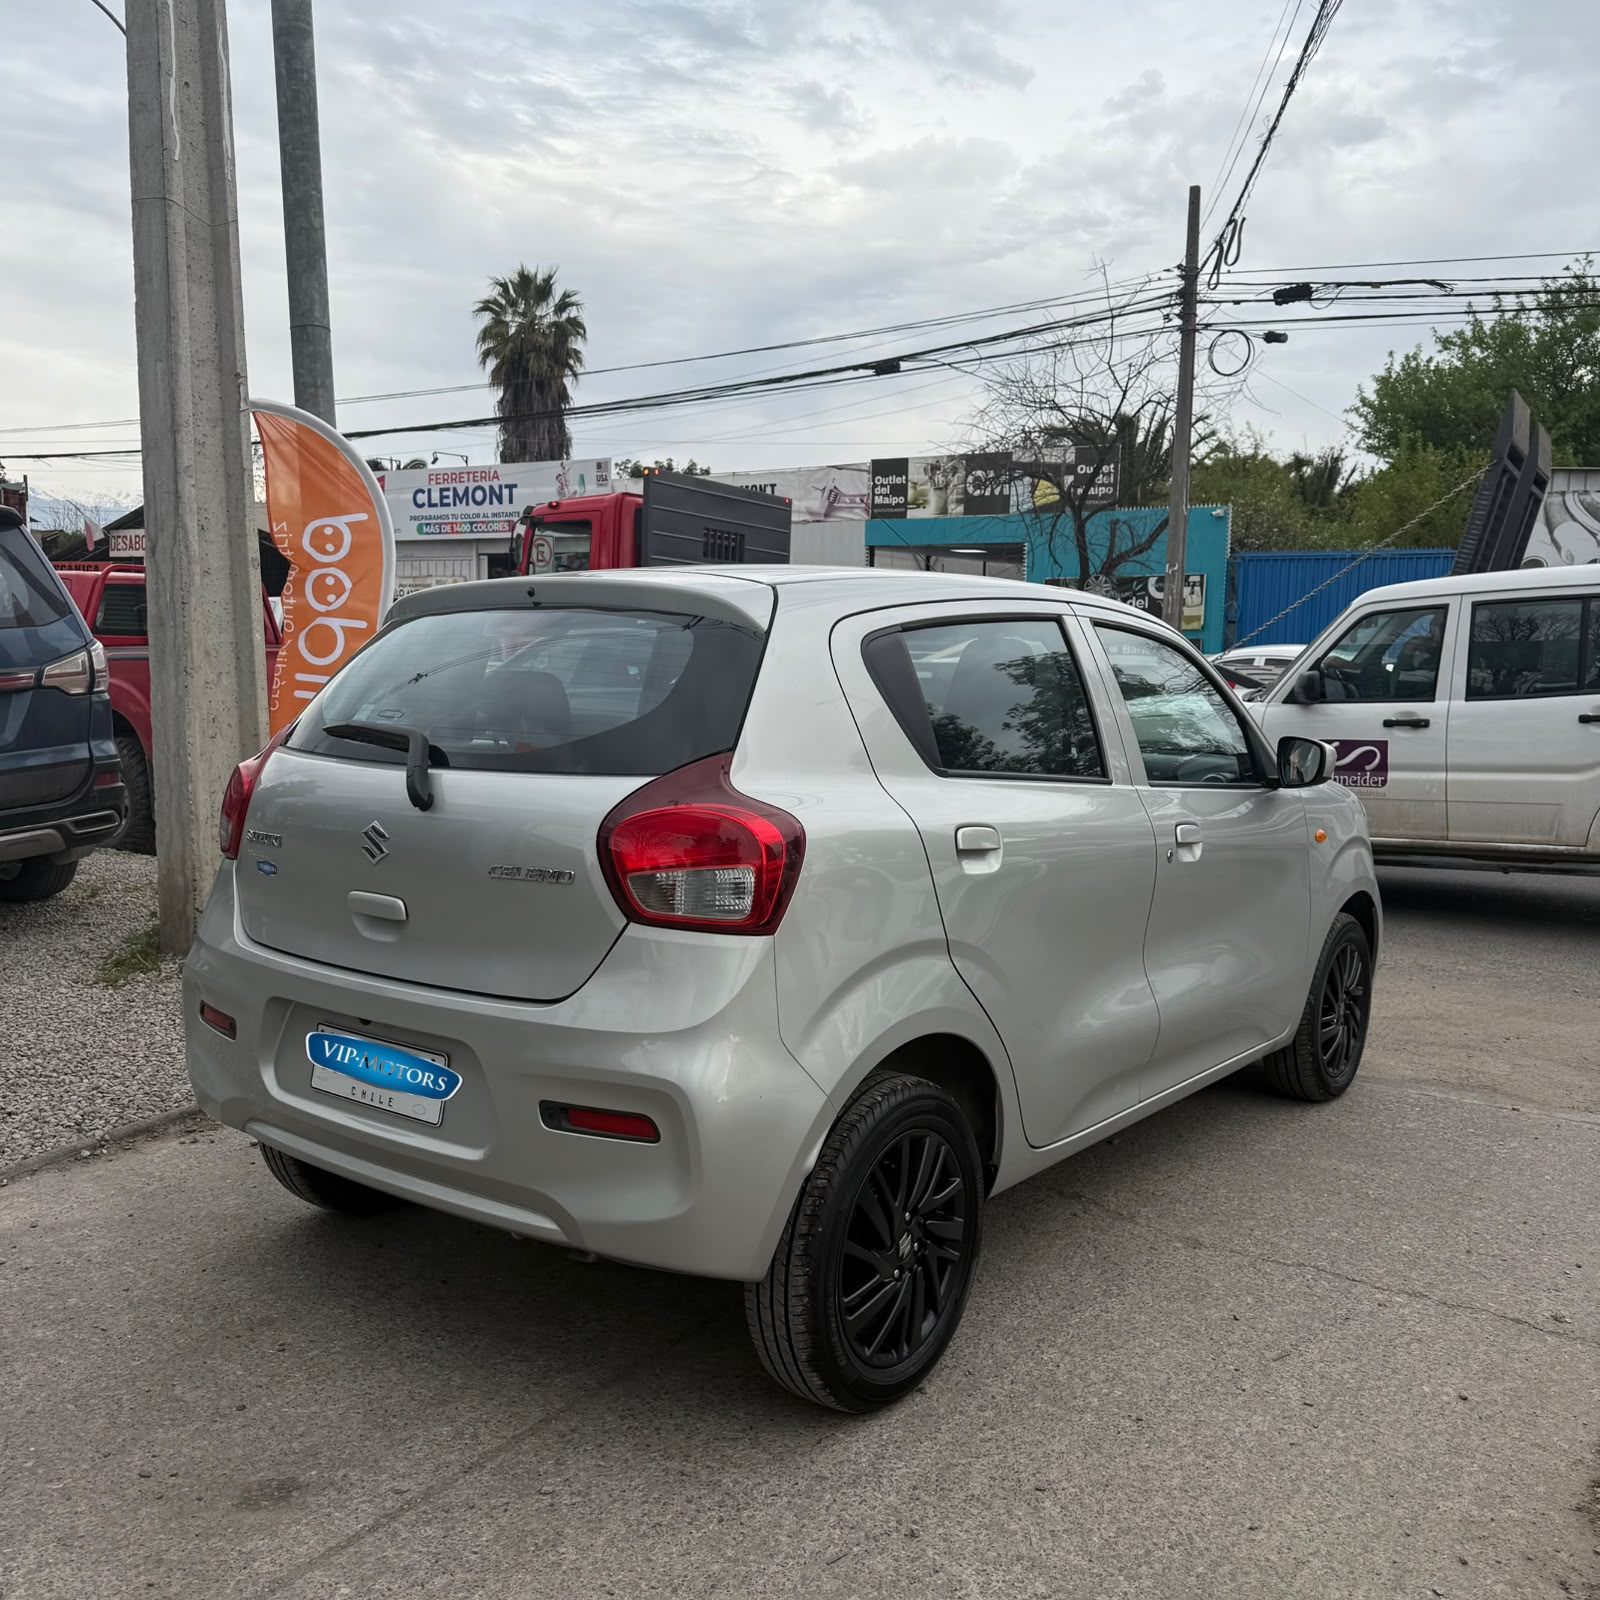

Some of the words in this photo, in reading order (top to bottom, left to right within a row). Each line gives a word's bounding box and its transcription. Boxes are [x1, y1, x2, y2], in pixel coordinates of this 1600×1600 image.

[428, 467, 500, 485] FERRETERÍA
[596, 474, 609, 482] USA
[874, 475, 906, 485] Outlet
[412, 483, 518, 509] CLEMONT
[874, 485, 890, 494] del
[874, 495, 905, 506] Maipo
[409, 514, 450, 522] PREPARAMOS
[460, 512, 481, 520] COLOR
[491, 511, 520, 519] INSTANTE
[441, 523, 451, 533] DE
[453, 522, 471, 533] 1400
[472, 521, 510, 532] COLORES
[110, 534, 146, 552] DESABO
[1332, 772, 1385, 787] hneider
[488, 865, 575, 885] CELERIO
[351, 1086, 393, 1107] CHILE
